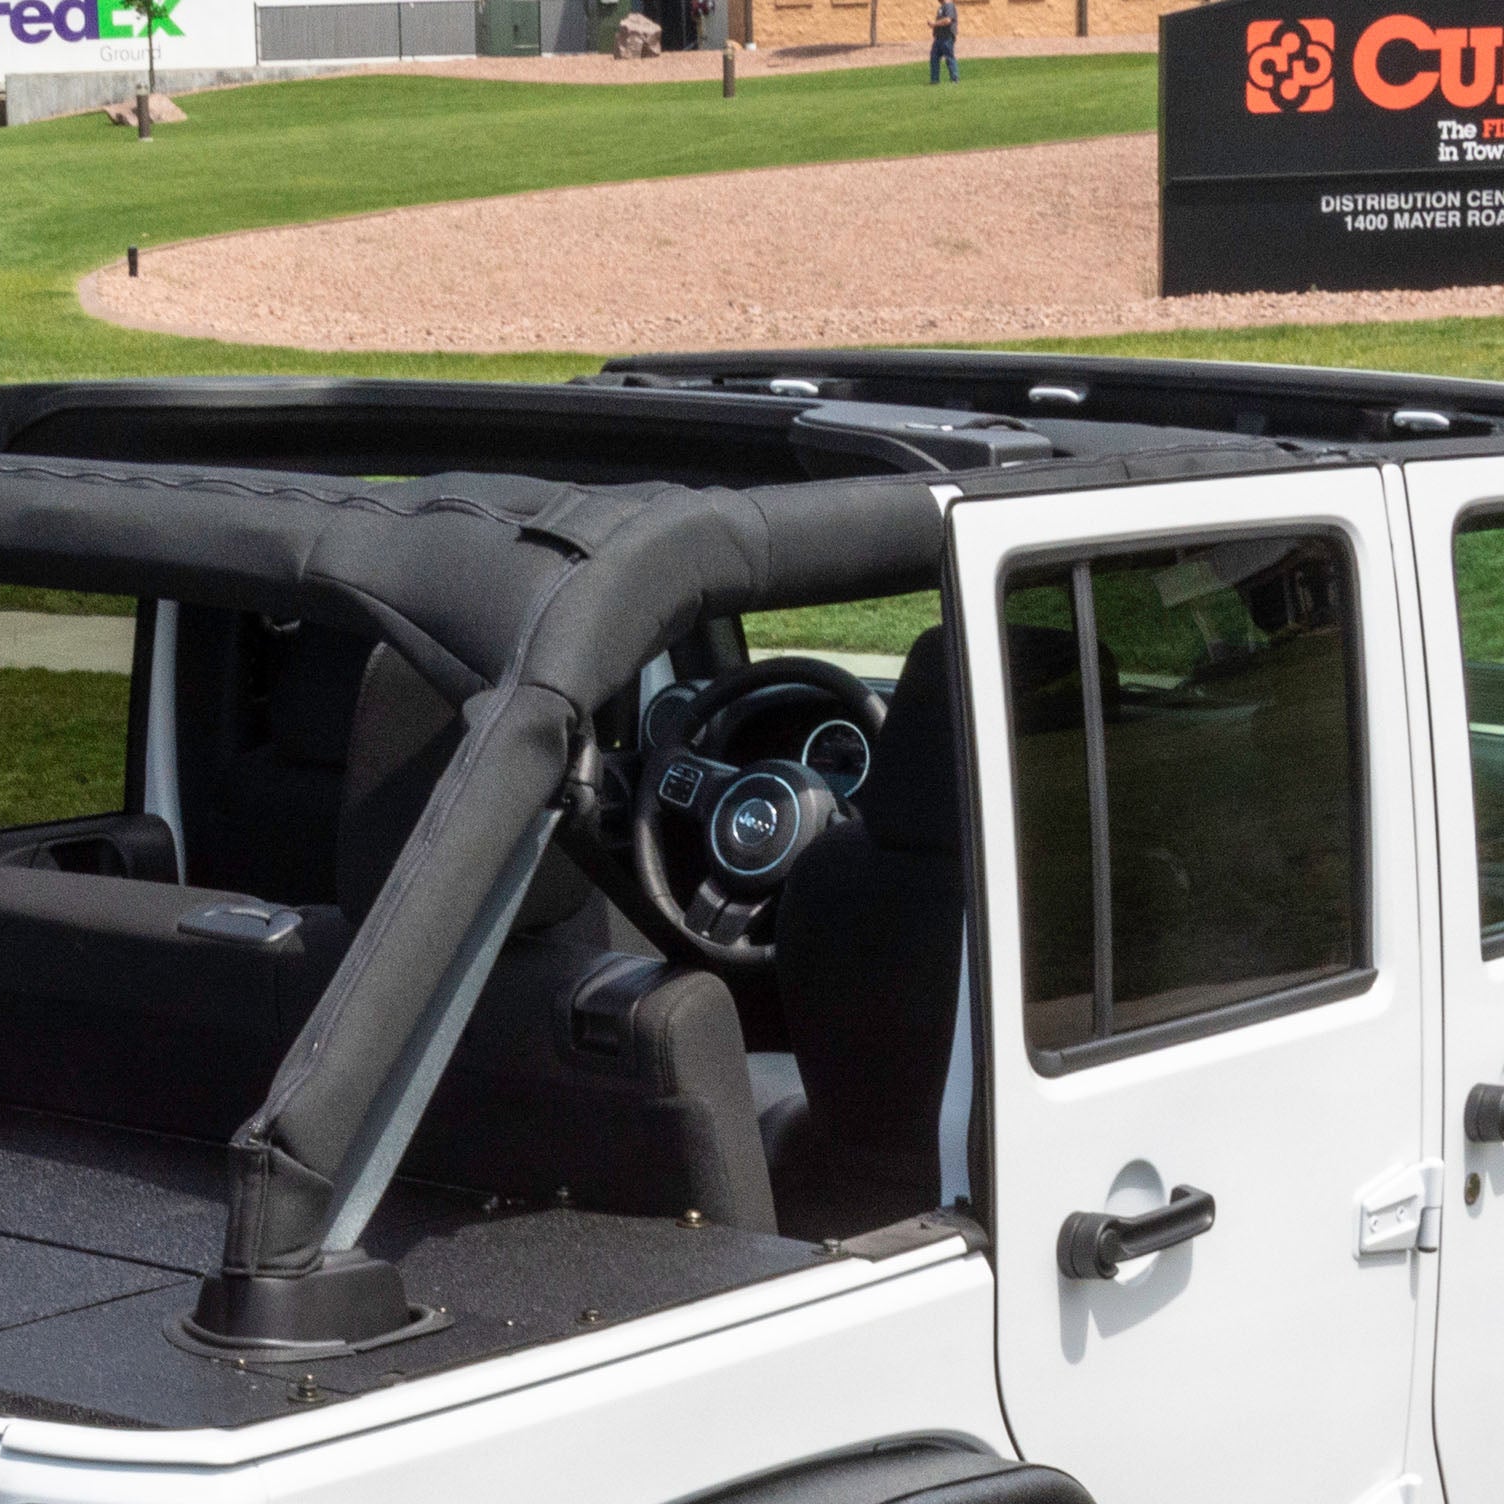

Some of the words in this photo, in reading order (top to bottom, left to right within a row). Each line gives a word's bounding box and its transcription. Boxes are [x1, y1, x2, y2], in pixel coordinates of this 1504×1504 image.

[1353, 14, 1504, 110] CU
[1437, 120, 1477, 140] The
[1482, 118, 1504, 138] FI
[1438, 142, 1459, 161] in
[1321, 191, 1461, 212] DISTRIBUTION
[1345, 213, 1388, 231] 1400
[1393, 211, 1461, 230] MAYER
